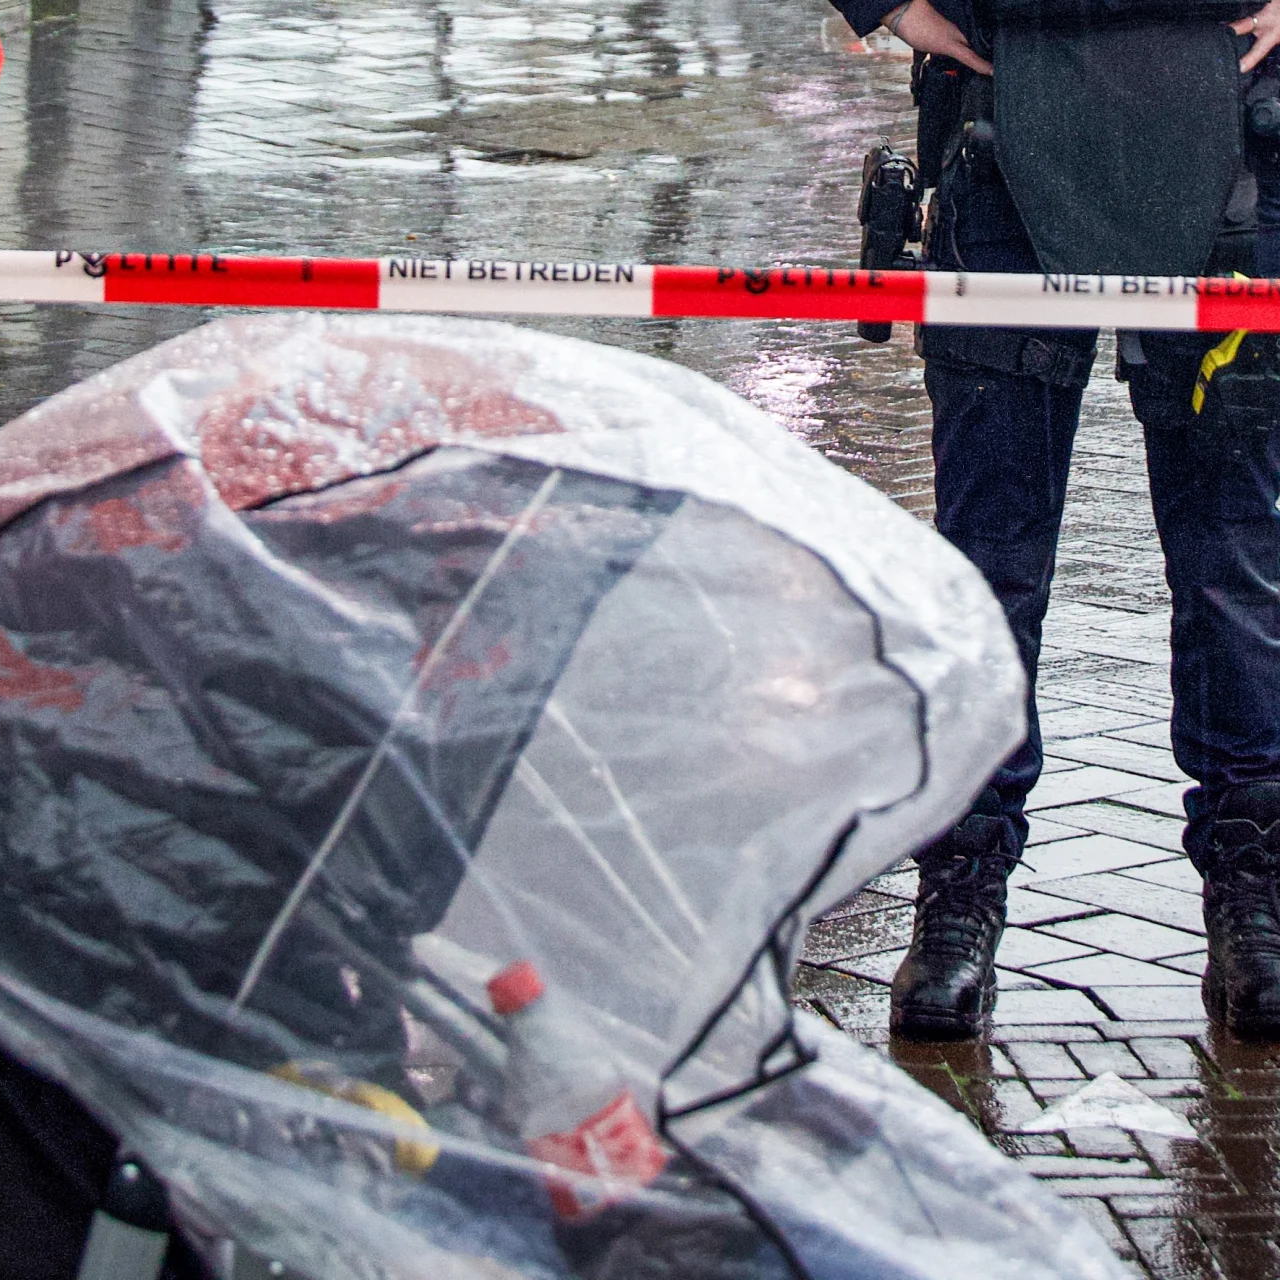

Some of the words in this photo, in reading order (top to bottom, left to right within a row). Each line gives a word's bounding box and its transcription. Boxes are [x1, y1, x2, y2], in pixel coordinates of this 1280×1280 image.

[389, 259, 458, 279] NIET
[468, 260, 634, 283] BETREDEN
[1042, 274, 1105, 293] NIET
